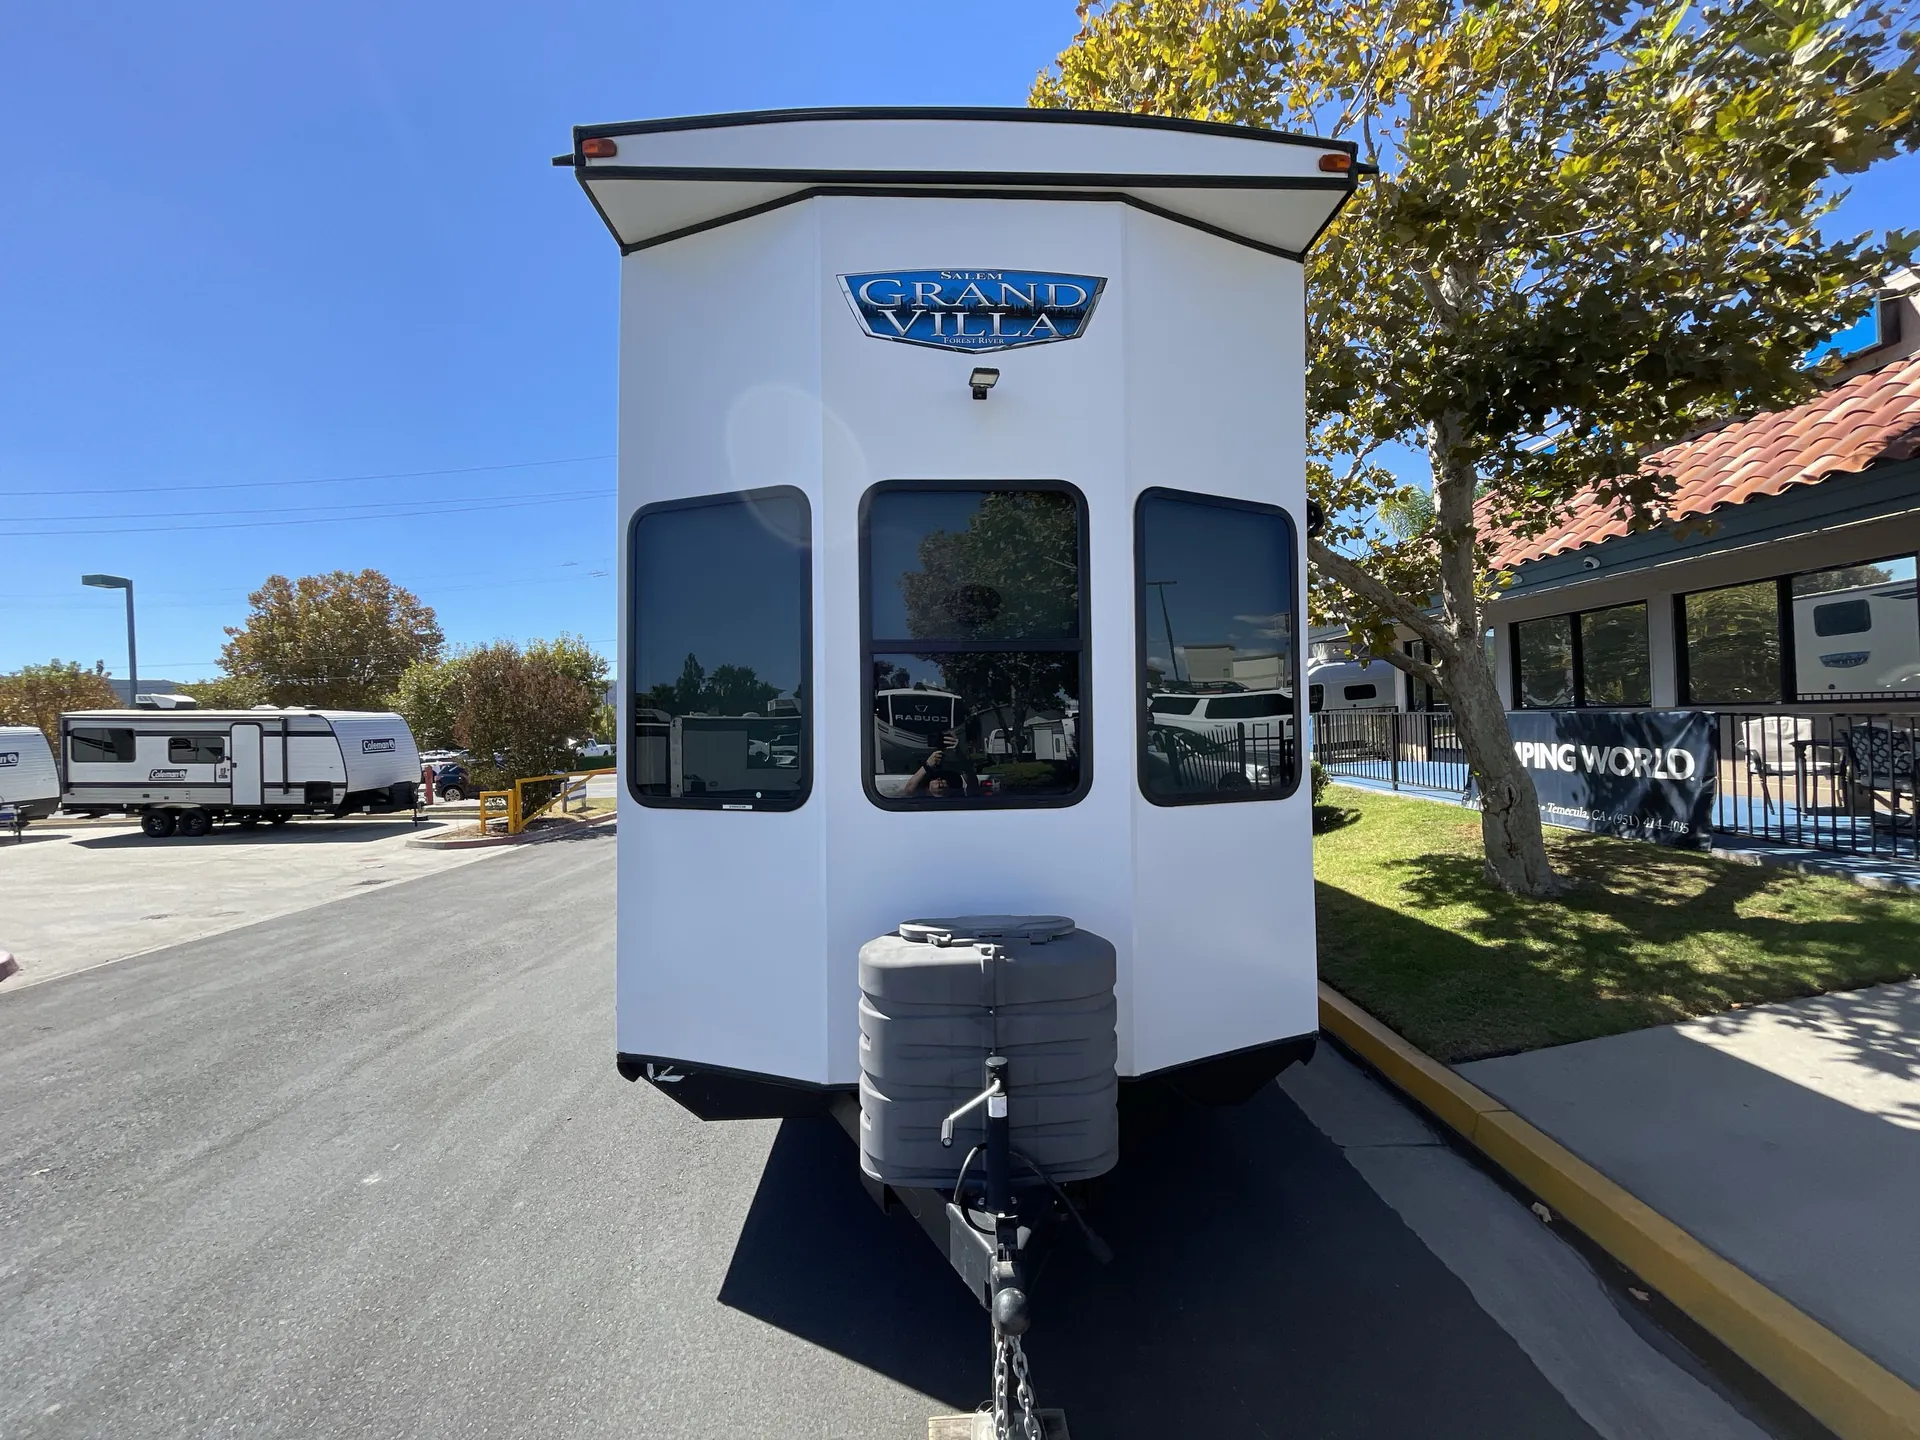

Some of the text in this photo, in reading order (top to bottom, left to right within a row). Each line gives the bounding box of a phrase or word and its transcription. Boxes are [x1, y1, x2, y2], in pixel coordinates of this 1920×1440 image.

[940, 270, 1003, 280] SALEM
[858, 279, 1088, 309] GRAND
[877, 309, 1061, 338] VILLA
[943, 336, 1005, 344] FOREST RIVER
[363, 740, 390, 751] Coleman
[151, 769, 180, 779] Coleman
[1591, 809, 1606, 822] CA
[1613, 812, 1640, 829] (951)
